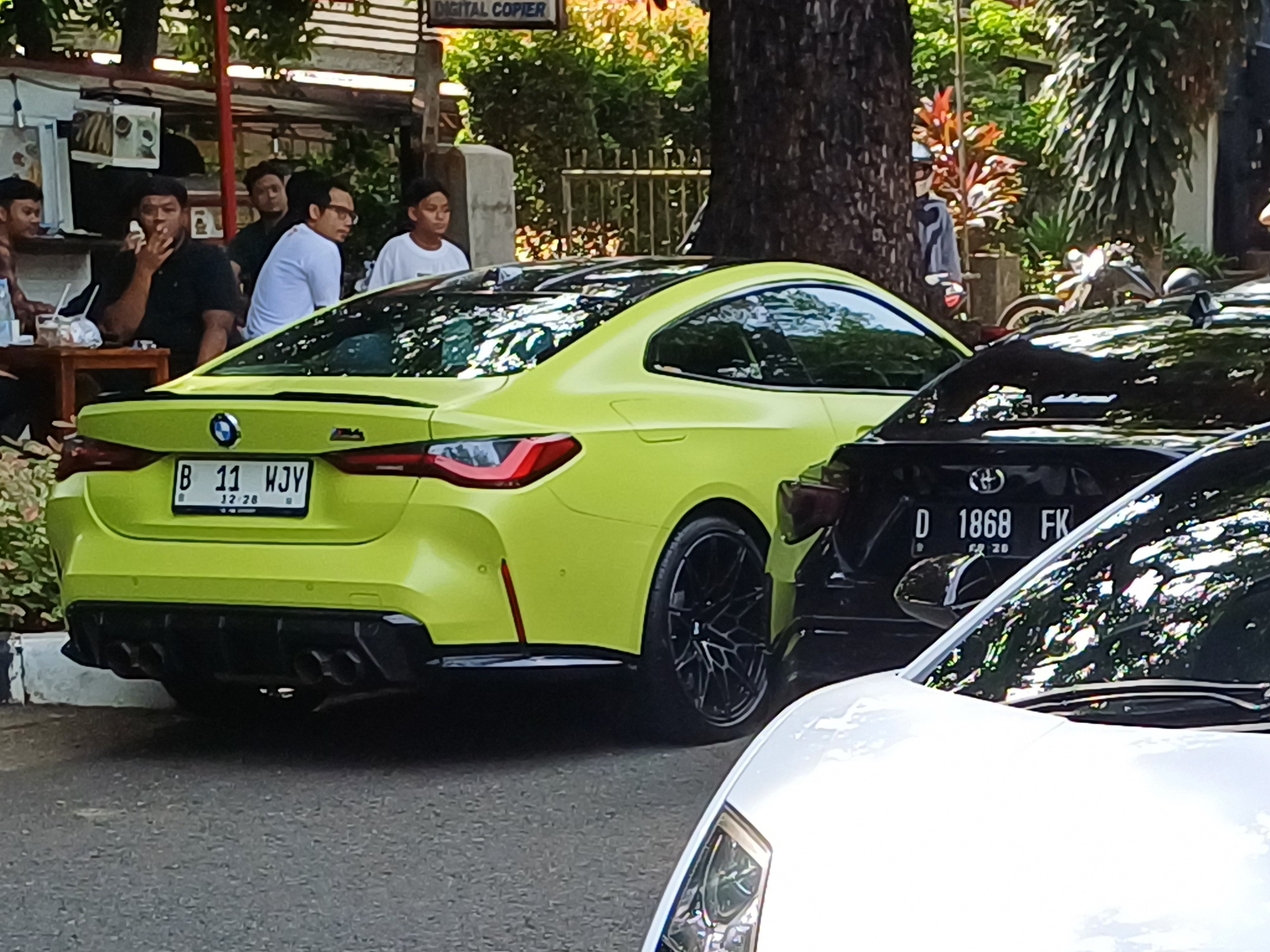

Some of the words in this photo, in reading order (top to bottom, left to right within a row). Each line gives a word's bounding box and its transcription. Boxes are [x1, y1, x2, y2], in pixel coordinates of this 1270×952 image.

[434, 1, 488, 17] DIGITAL
[492, 2, 547, 18] COPIER
[180, 464, 192, 491] B
[215, 464, 240, 492] 11
[265, 465, 304, 493] WJY
[915, 508, 930, 539] D
[959, 508, 1012, 539] 1868
[1041, 508, 1070, 540] FK
